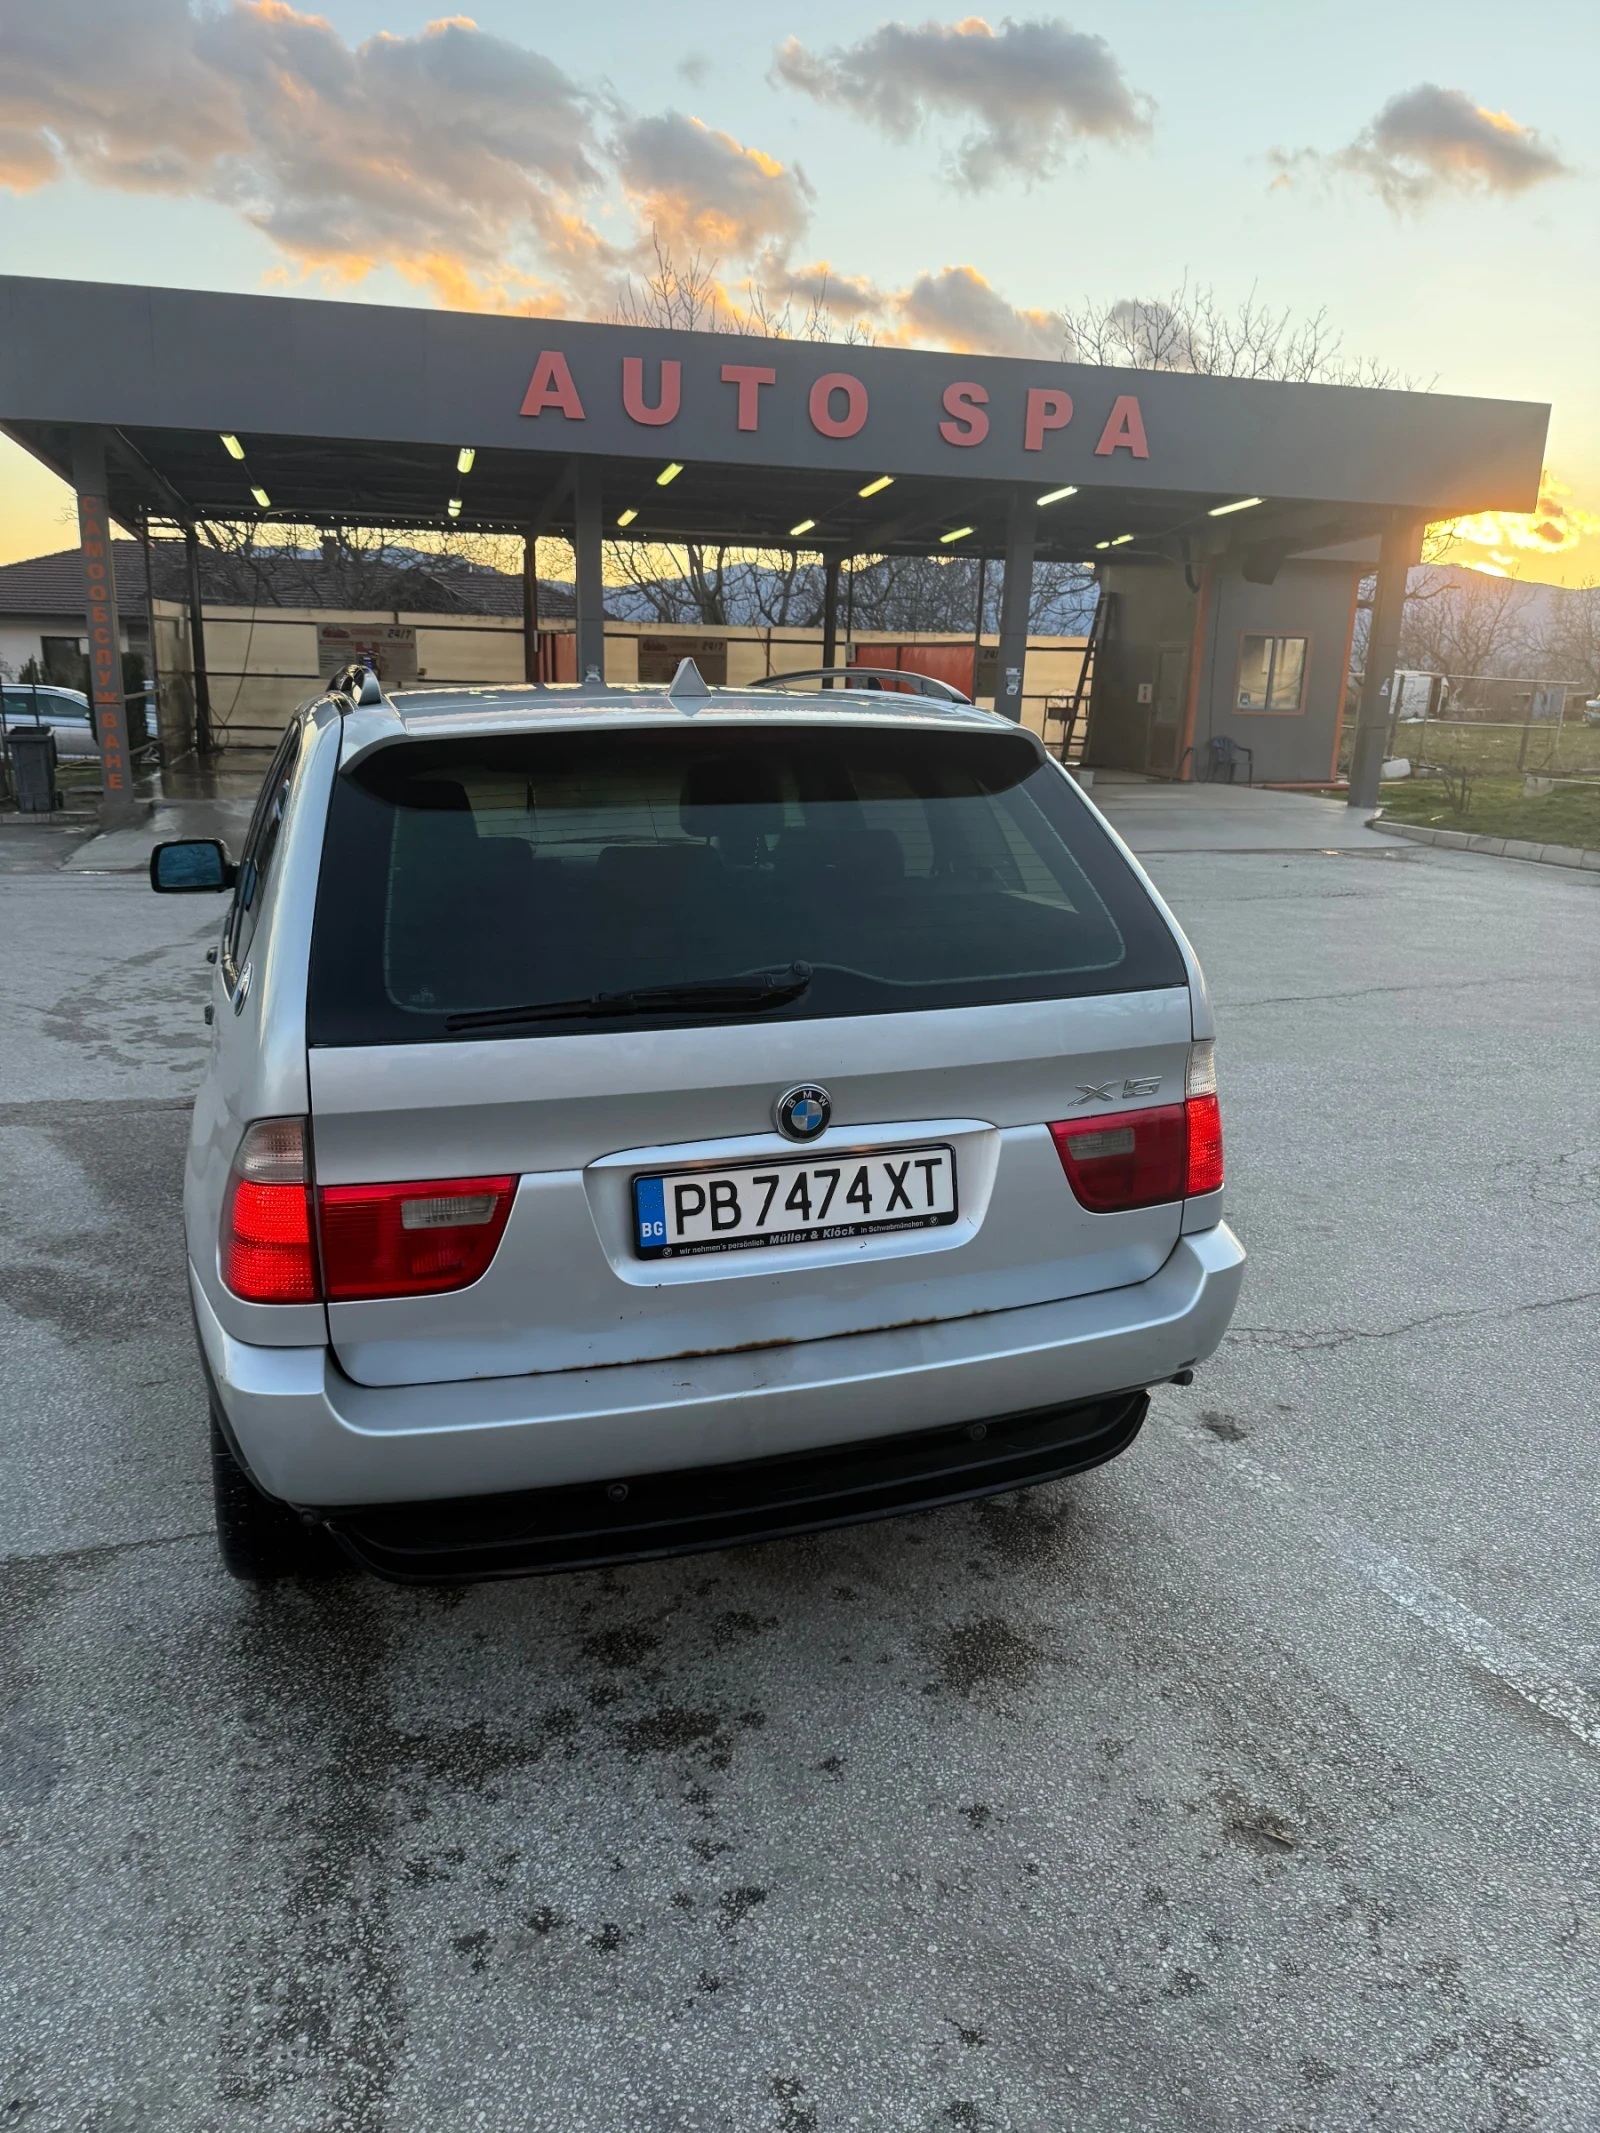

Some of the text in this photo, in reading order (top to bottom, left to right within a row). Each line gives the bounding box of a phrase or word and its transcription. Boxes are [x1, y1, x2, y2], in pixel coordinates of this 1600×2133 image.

[519, 350, 1150, 459] AUTO SPA
[387, 628, 413, 639] 24/7
[786, 1090, 829, 1109] BMW
[1067, 1075, 1163, 1107] X5
[641, 1221, 664, 1238] BG
[769, 1231, 807, 1245] Müller
[810, 1231, 819, 1240] &
[822, 1226, 856, 1239] Klöck
